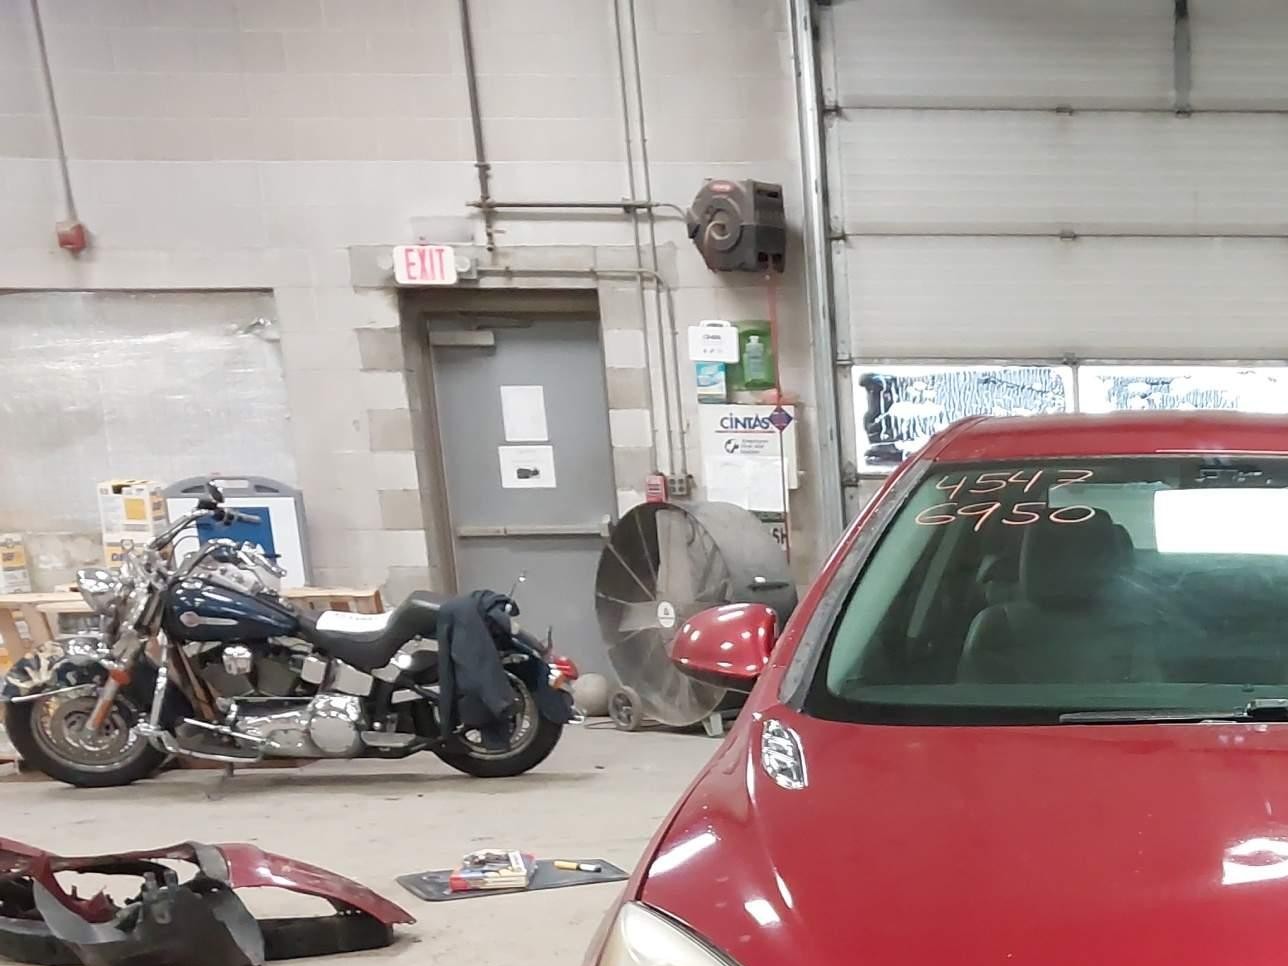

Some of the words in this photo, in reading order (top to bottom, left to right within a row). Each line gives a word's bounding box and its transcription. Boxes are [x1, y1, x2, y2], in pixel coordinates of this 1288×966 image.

[404, 248, 445, 280] EXIT
[720, 412, 770, 430] CINTAS
[935, 469, 1094, 500] 4547
[914, 501, 1096, 532] 6950
